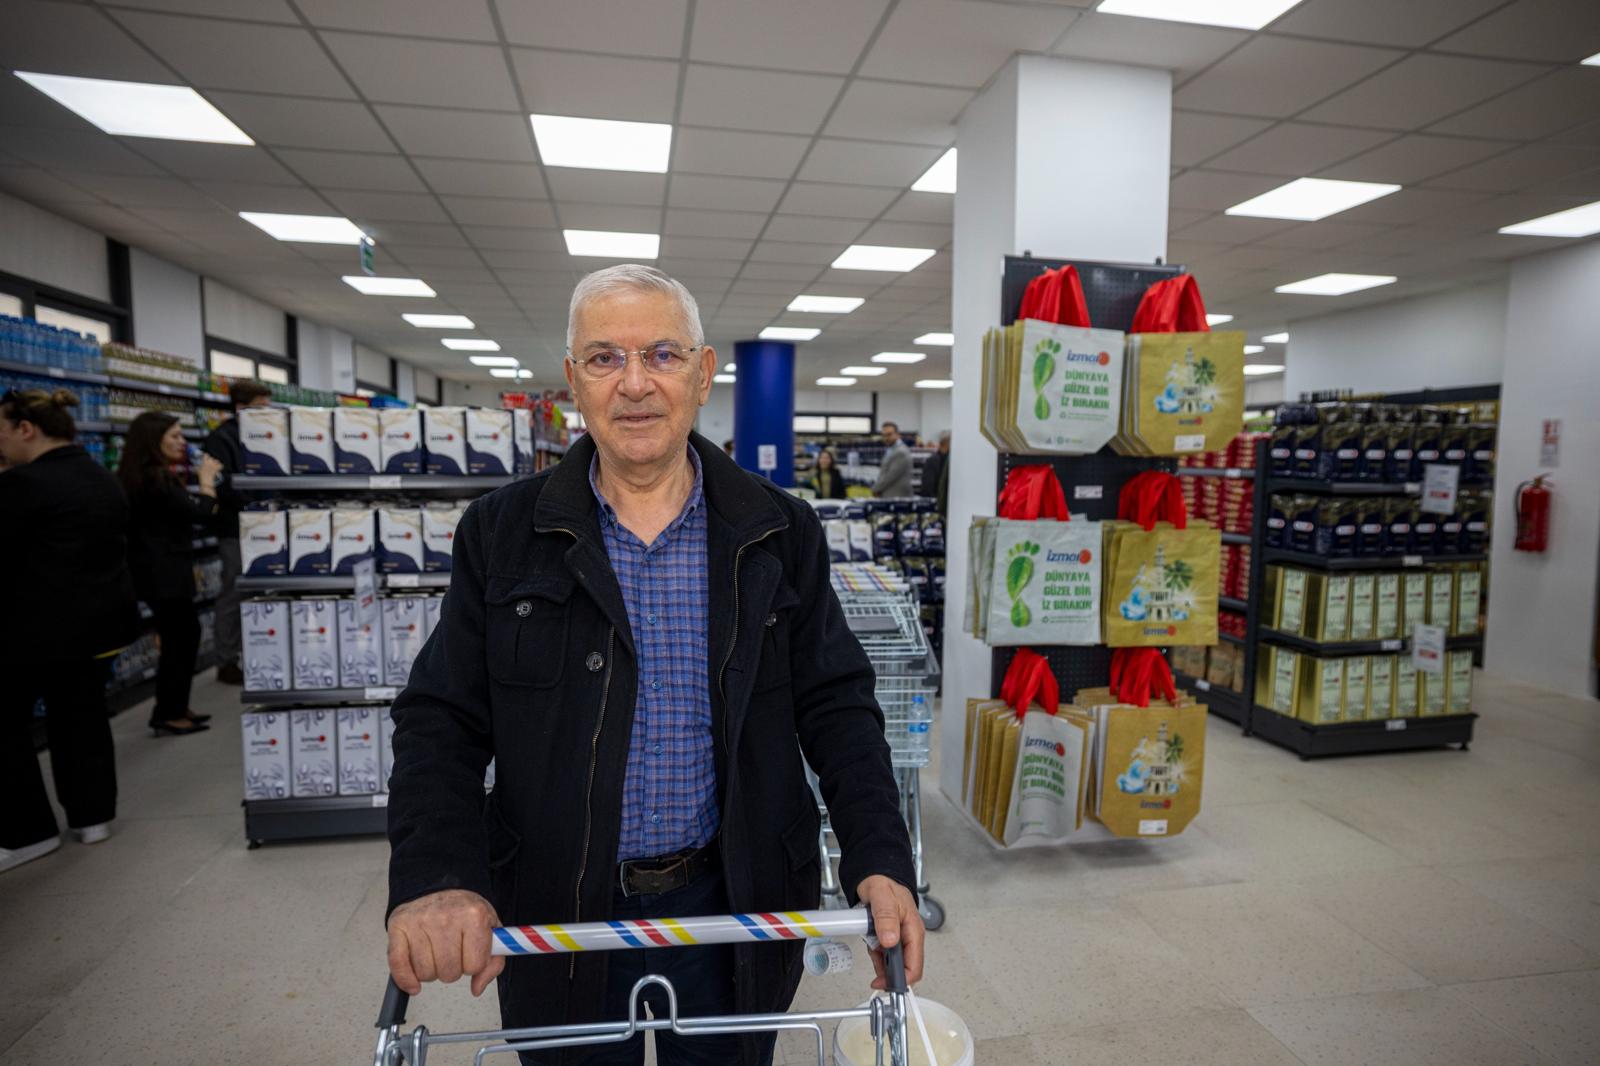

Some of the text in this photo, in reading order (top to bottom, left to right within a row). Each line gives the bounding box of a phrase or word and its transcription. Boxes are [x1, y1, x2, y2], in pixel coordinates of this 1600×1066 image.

[1065, 369, 1109, 382] DÜNYAYA
[1064, 382, 1109, 396] GÜZEL BİR
[1061, 395, 1110, 409] İZ BIRAKIN
[1045, 570, 1090, 582] DÜNYAYA
[1043, 584, 1092, 596] GÜZEL BİR
[1042, 598, 1093, 611] İZ BIRAKIN
